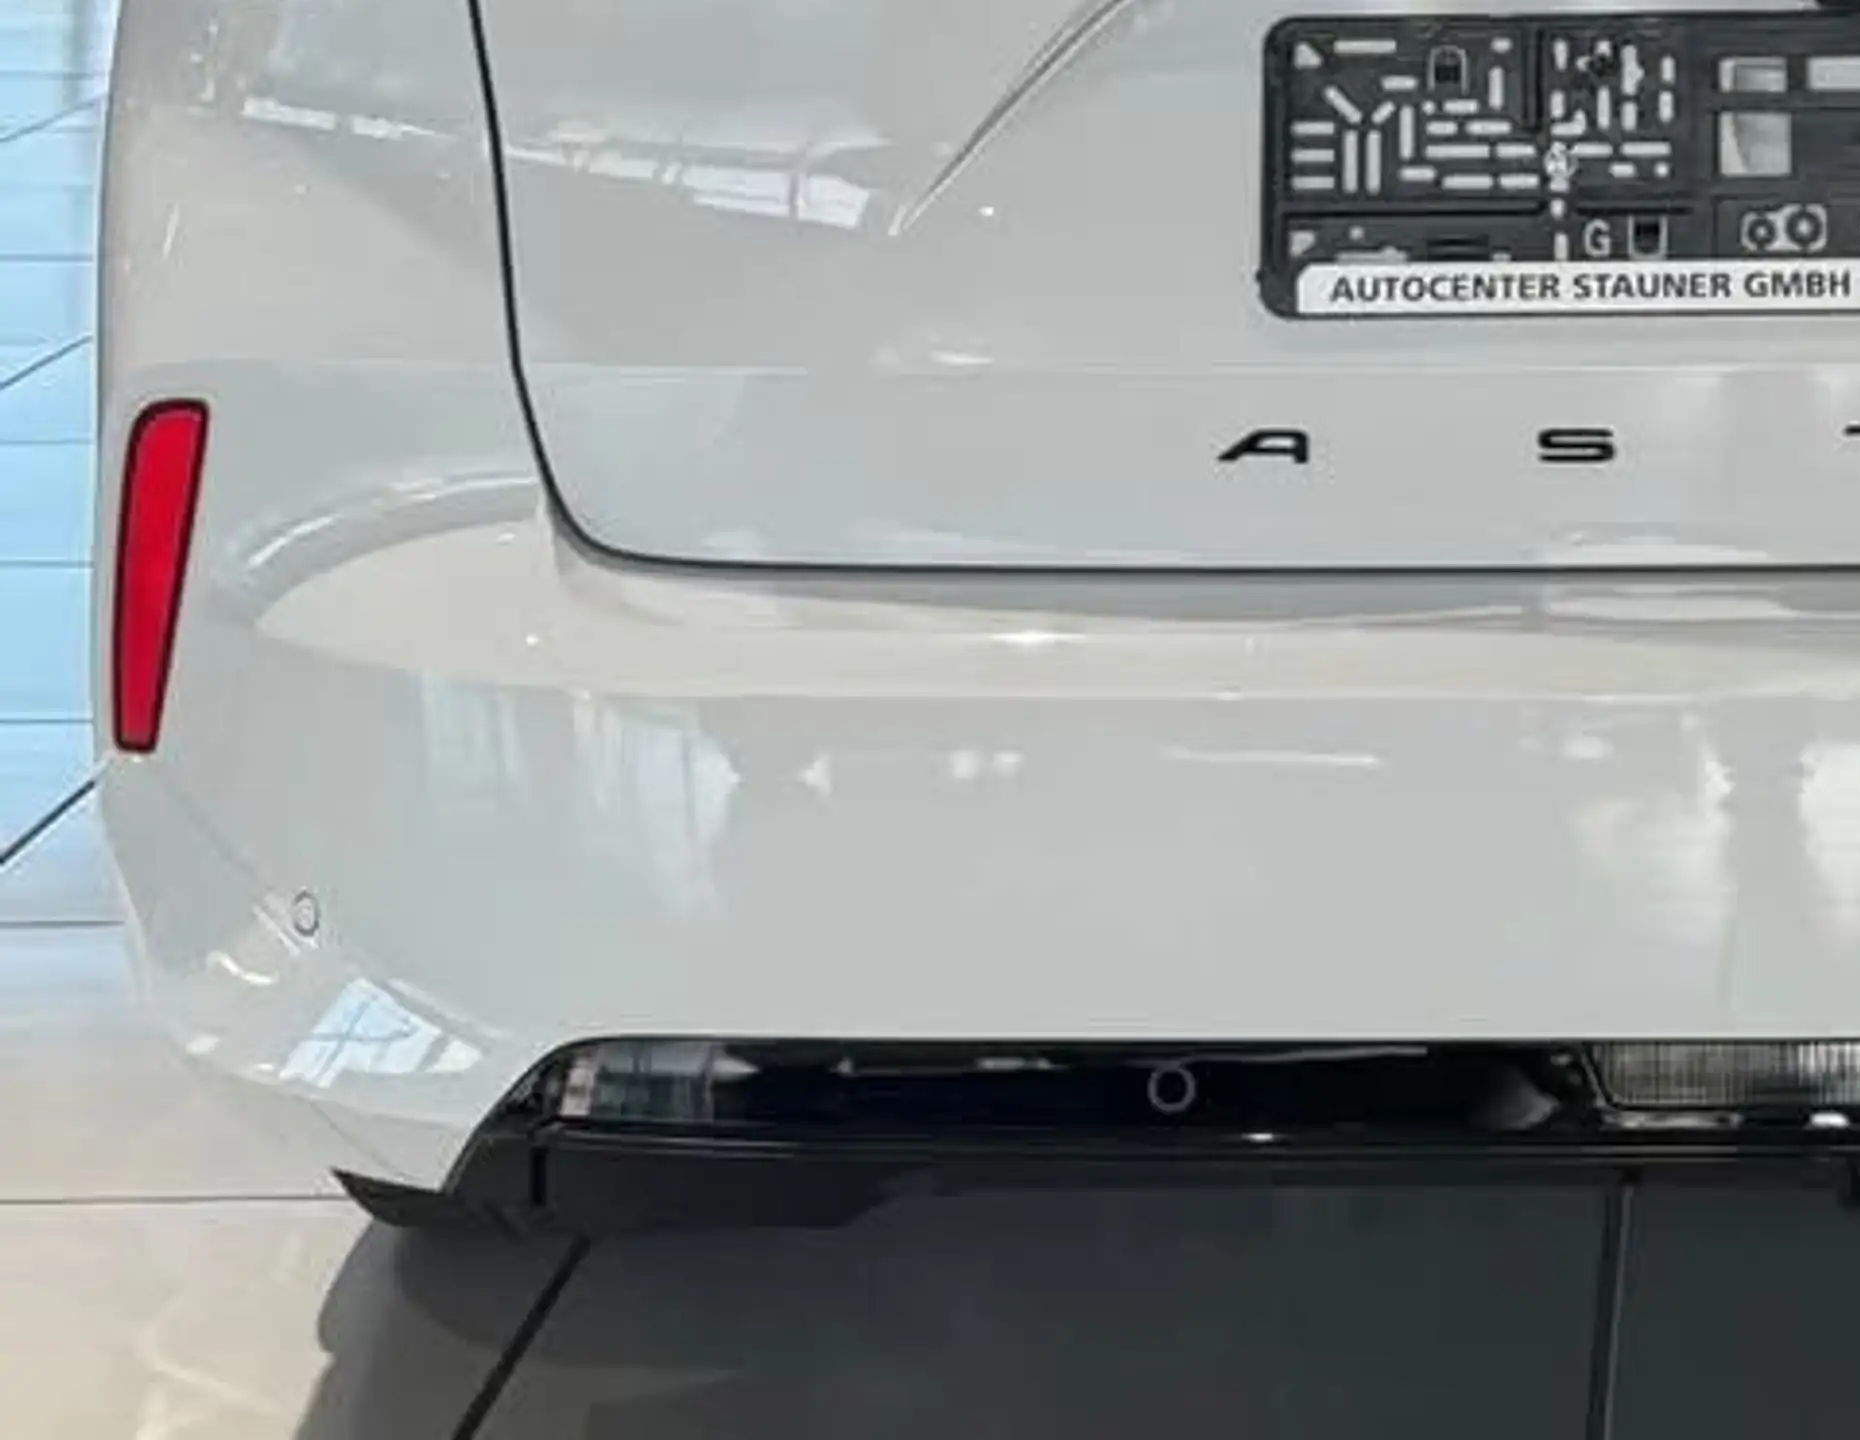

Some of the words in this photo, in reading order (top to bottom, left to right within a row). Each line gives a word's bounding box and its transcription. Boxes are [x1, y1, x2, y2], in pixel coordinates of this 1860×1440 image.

[1329, 272, 1560, 303] AUTOCENTER
[1573, 271, 1732, 300] STAUNER
[1744, 270, 1851, 299] GMBH
